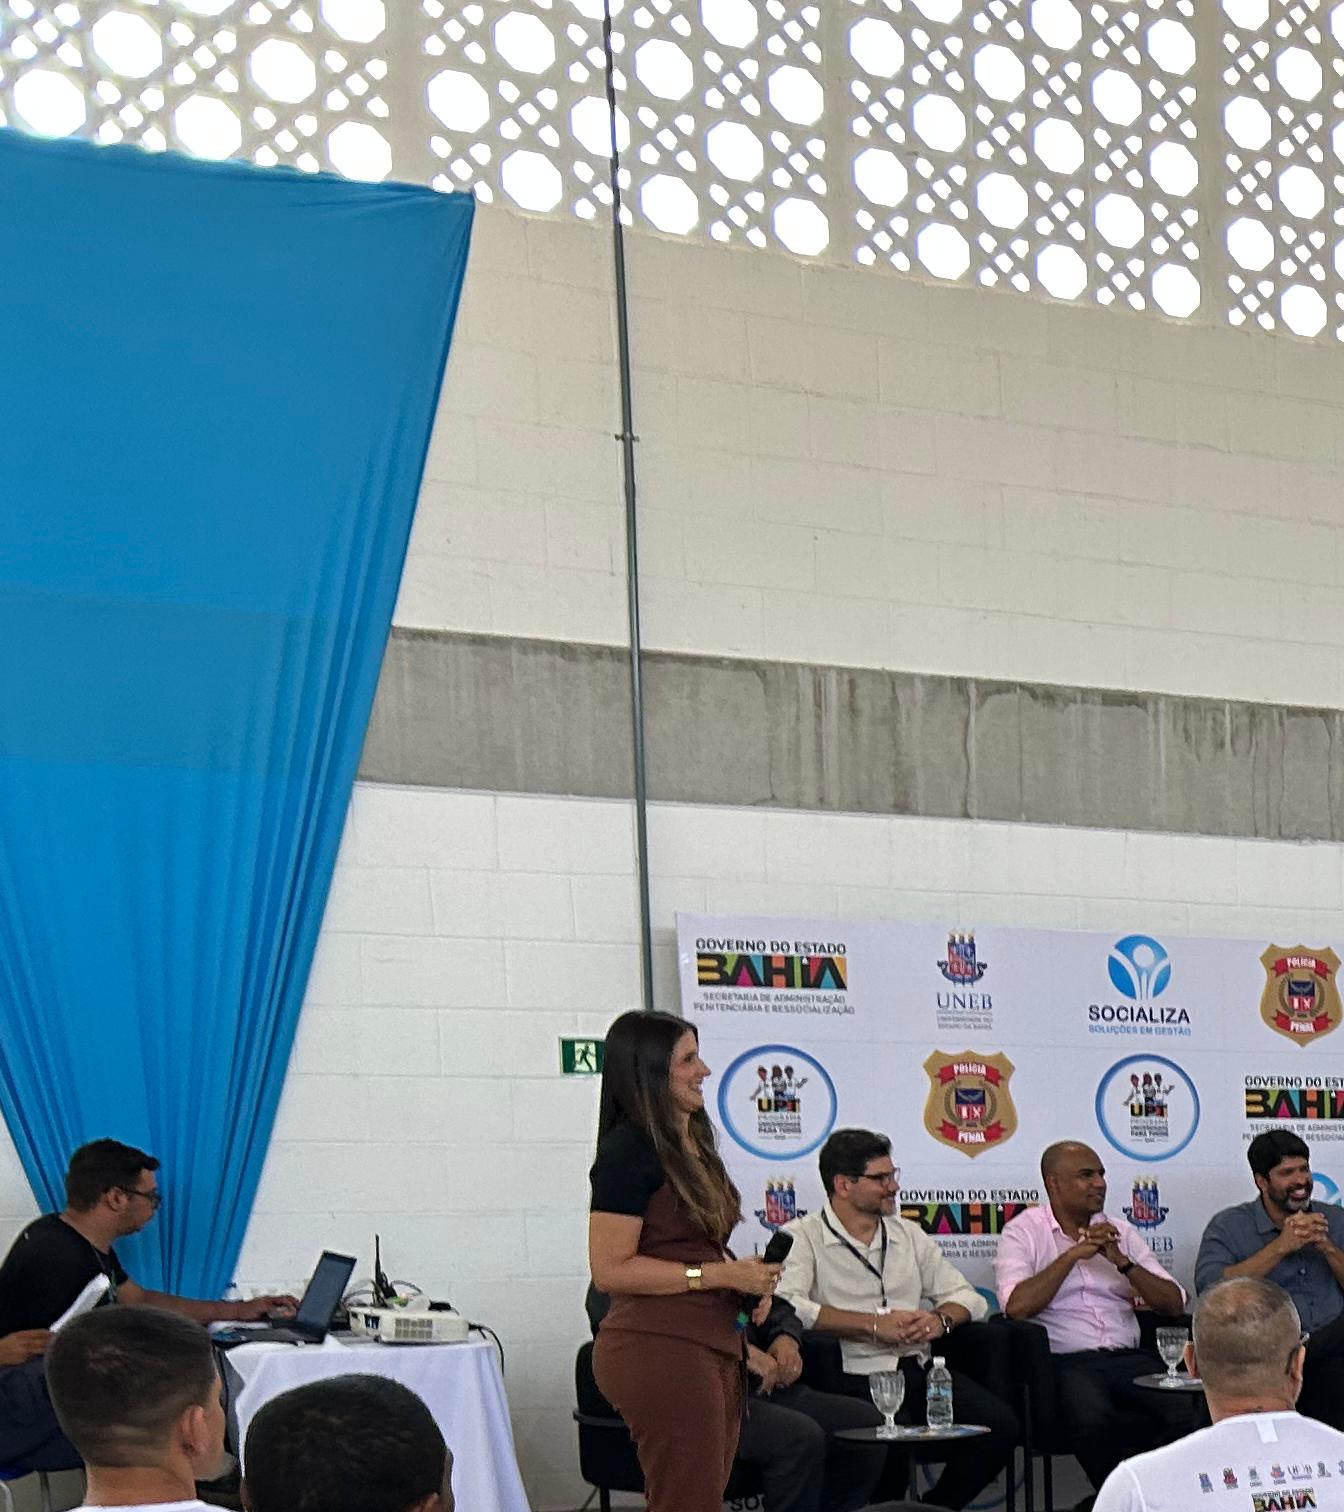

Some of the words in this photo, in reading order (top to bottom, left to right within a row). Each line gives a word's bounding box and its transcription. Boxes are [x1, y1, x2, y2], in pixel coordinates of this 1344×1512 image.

[696, 937, 766, 952] GOVERNO
[770, 940, 791, 952] DO
[794, 941, 846, 955] ESTADO
[696, 953, 847, 990] BAHIA
[703, 991, 758, 1002] SECRETARIA
[774, 993, 846, 1005] ADMINISTRAÇÃO
[936, 992, 993, 1010] UNEB
[693, 1002, 763, 1013] PENITENCIÁRIA
[772, 1003, 855, 1016] RESSOCIALIZAÇÃO
[1088, 1005, 1190, 1024] SOCIALIZA
[1088, 1024, 1138, 1035] SOLUÇÕES
[1140, 1025, 1153, 1035] EM
[1154, 1024, 1192, 1036] GESTÃO
[1245, 1075, 1302, 1087] GOVERNO
[1305, 1077, 1322, 1087] DO
[900, 1190, 964, 1202] GOVERNO
[969, 1190, 987, 1202] DO
[990, 1190, 1039, 1202] ESTADO
